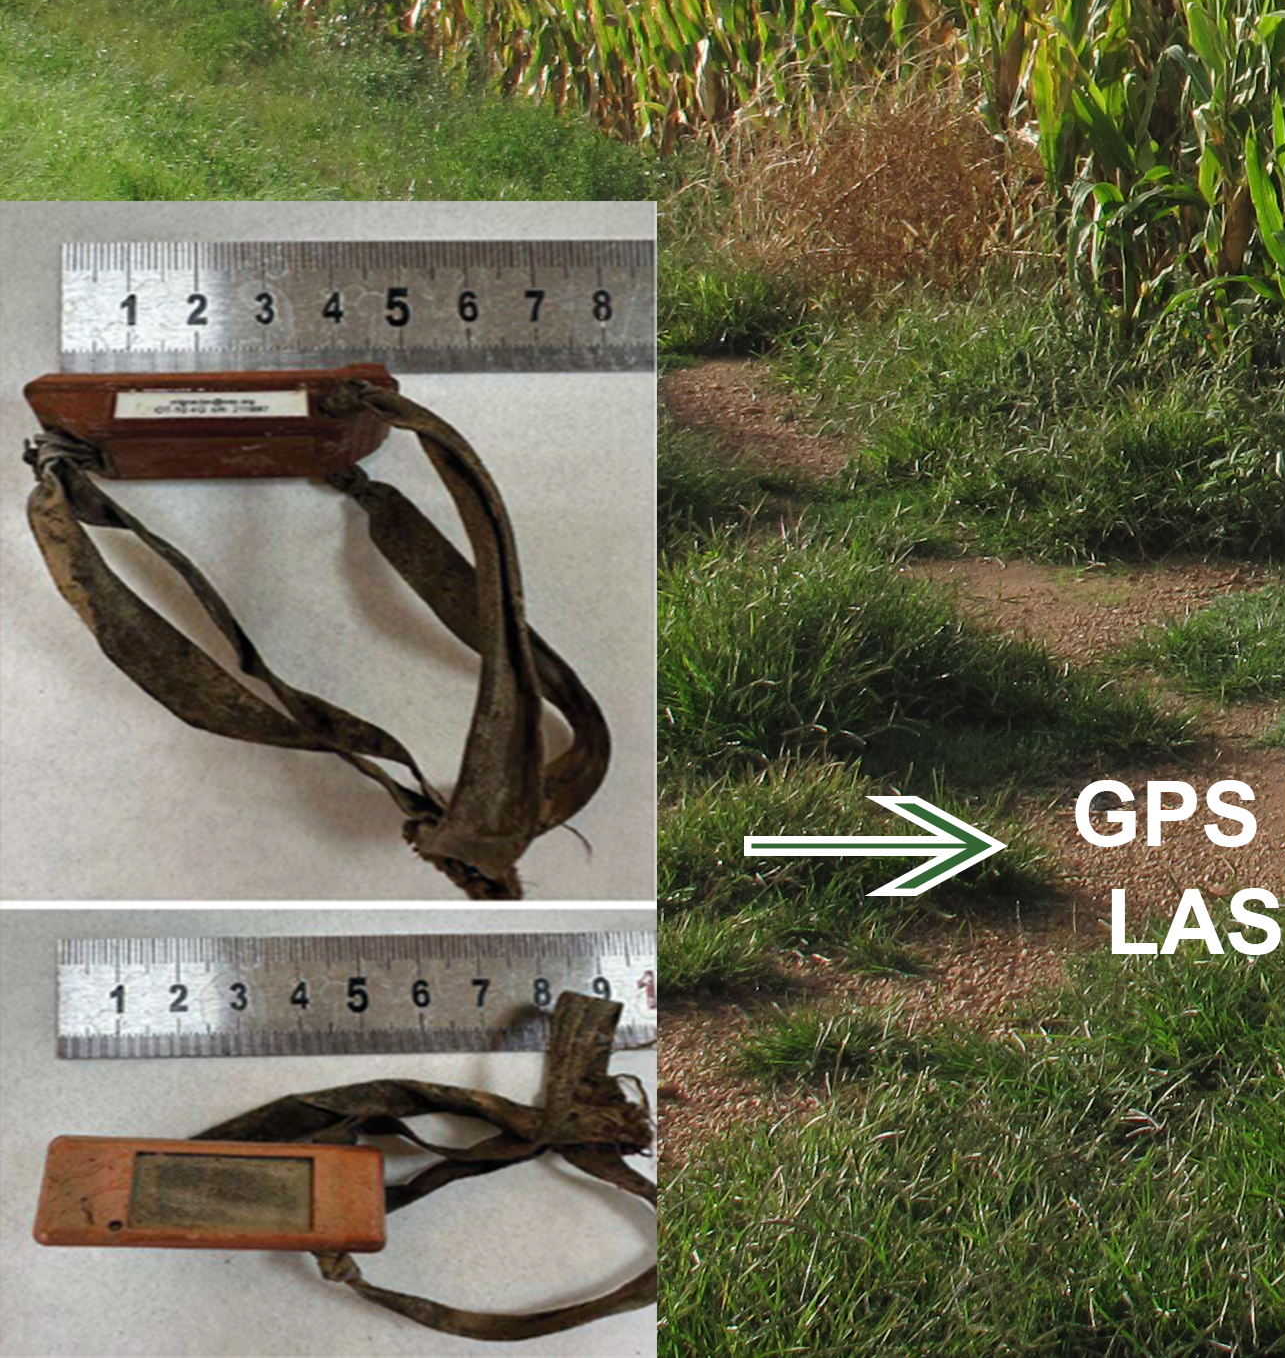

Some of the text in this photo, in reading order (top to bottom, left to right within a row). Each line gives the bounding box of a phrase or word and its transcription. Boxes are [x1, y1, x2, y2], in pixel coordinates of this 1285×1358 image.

[120, 287, 613, 327] 1 2 3 4 5 6 7 8
[110, 984, 125, 1014] 1
[169, 984, 189, 1012] 2
[230, 982, 248, 1011] 3
[290, 981, 309, 1010] 4
[346, 977, 369, 1013] 5
[411, 979, 431, 1007] 6
[472, 978, 490, 1007] 7
[533, 978, 552, 1006] 8
[592, 976, 612, 1001] 9
